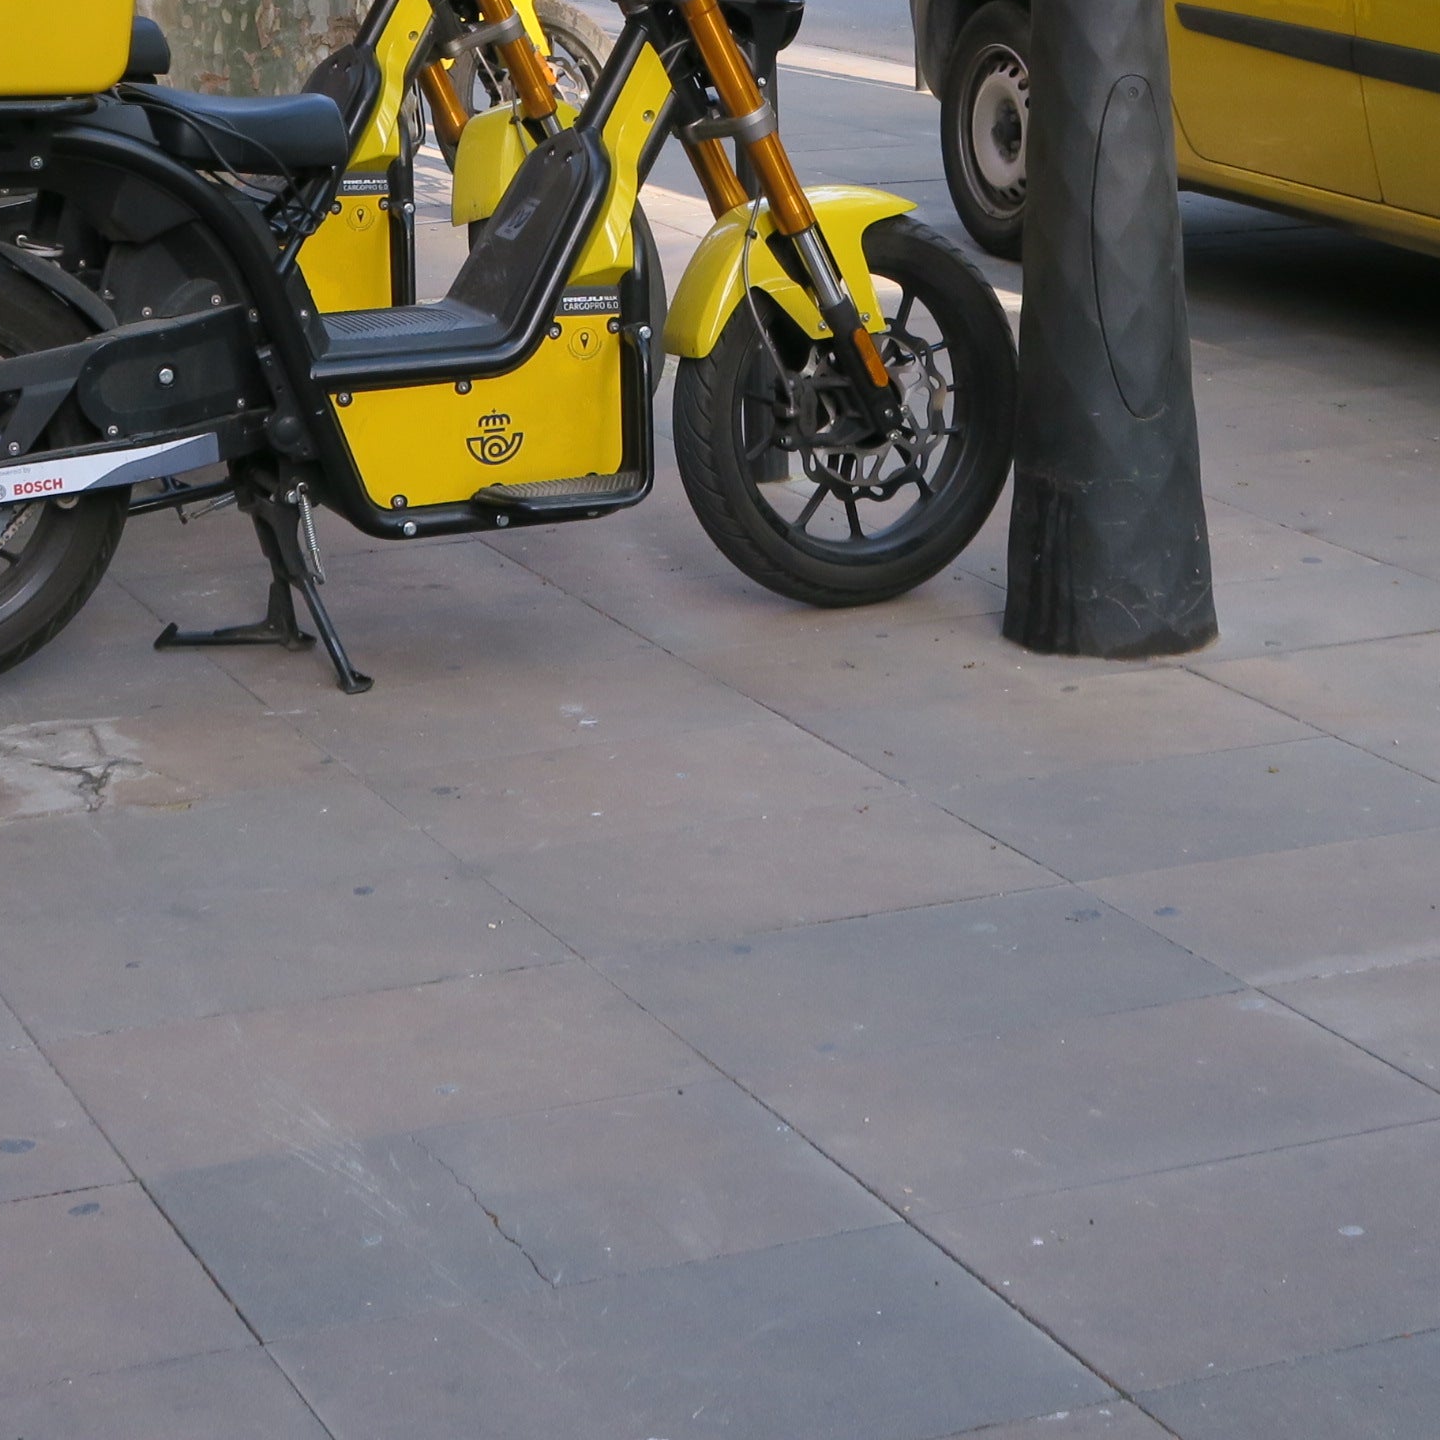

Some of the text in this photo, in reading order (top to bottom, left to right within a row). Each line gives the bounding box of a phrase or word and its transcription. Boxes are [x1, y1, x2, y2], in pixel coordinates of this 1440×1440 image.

[563, 301, 619, 311] CARGOPRO 6.0
[13, 477, 63, 496] BOSCH
